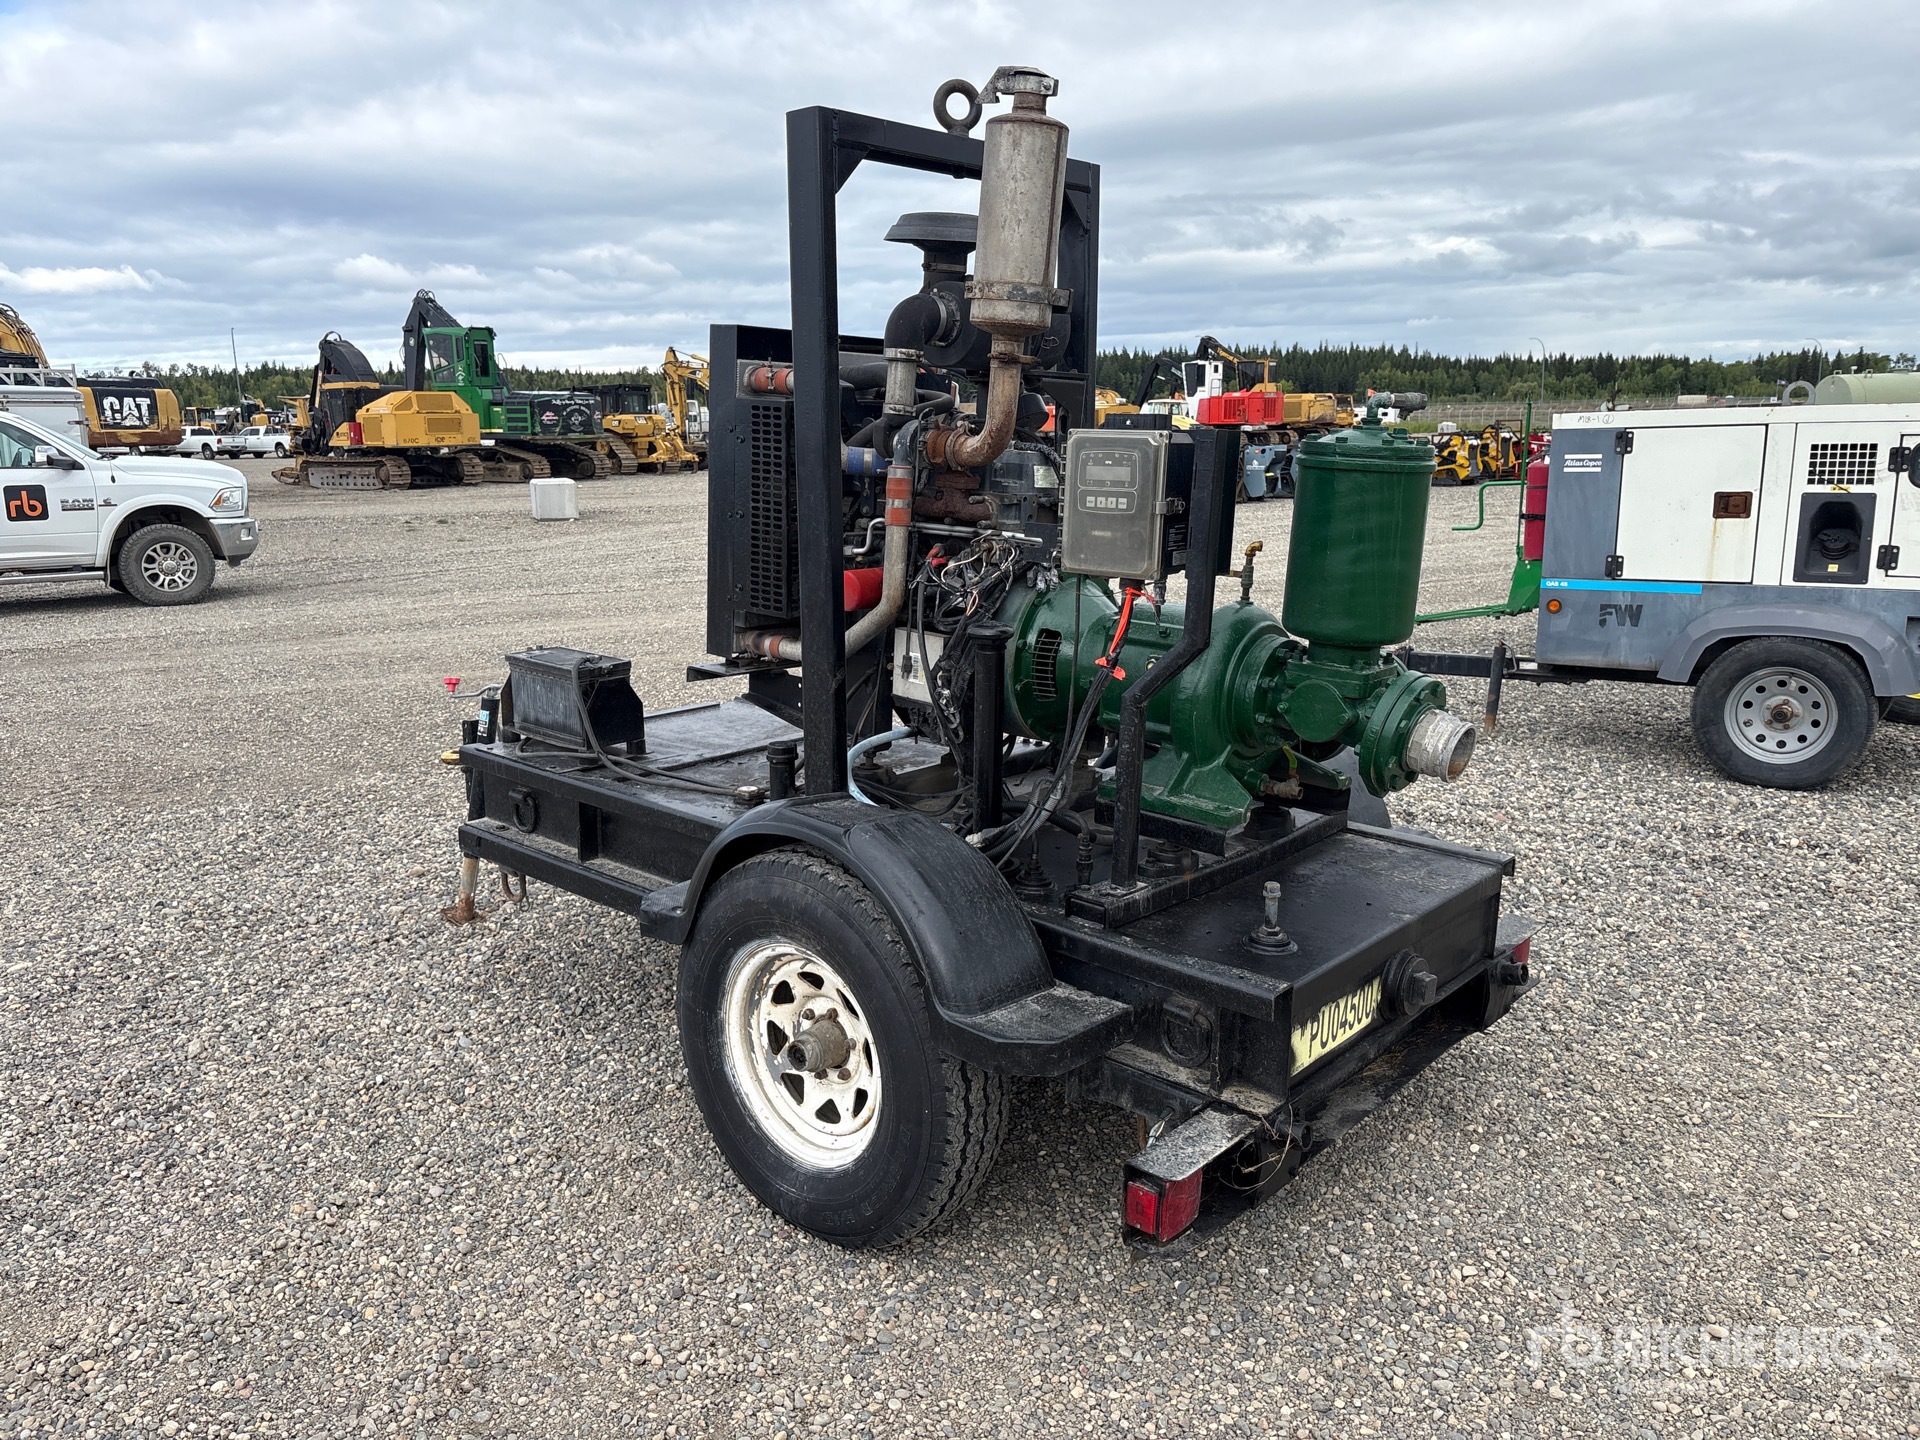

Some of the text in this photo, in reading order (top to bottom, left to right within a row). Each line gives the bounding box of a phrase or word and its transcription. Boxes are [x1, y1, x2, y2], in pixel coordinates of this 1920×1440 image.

[102, 396, 151, 426] CAT
[1583, 459, 1602, 468] Copco
[9, 490, 43, 518] rb
